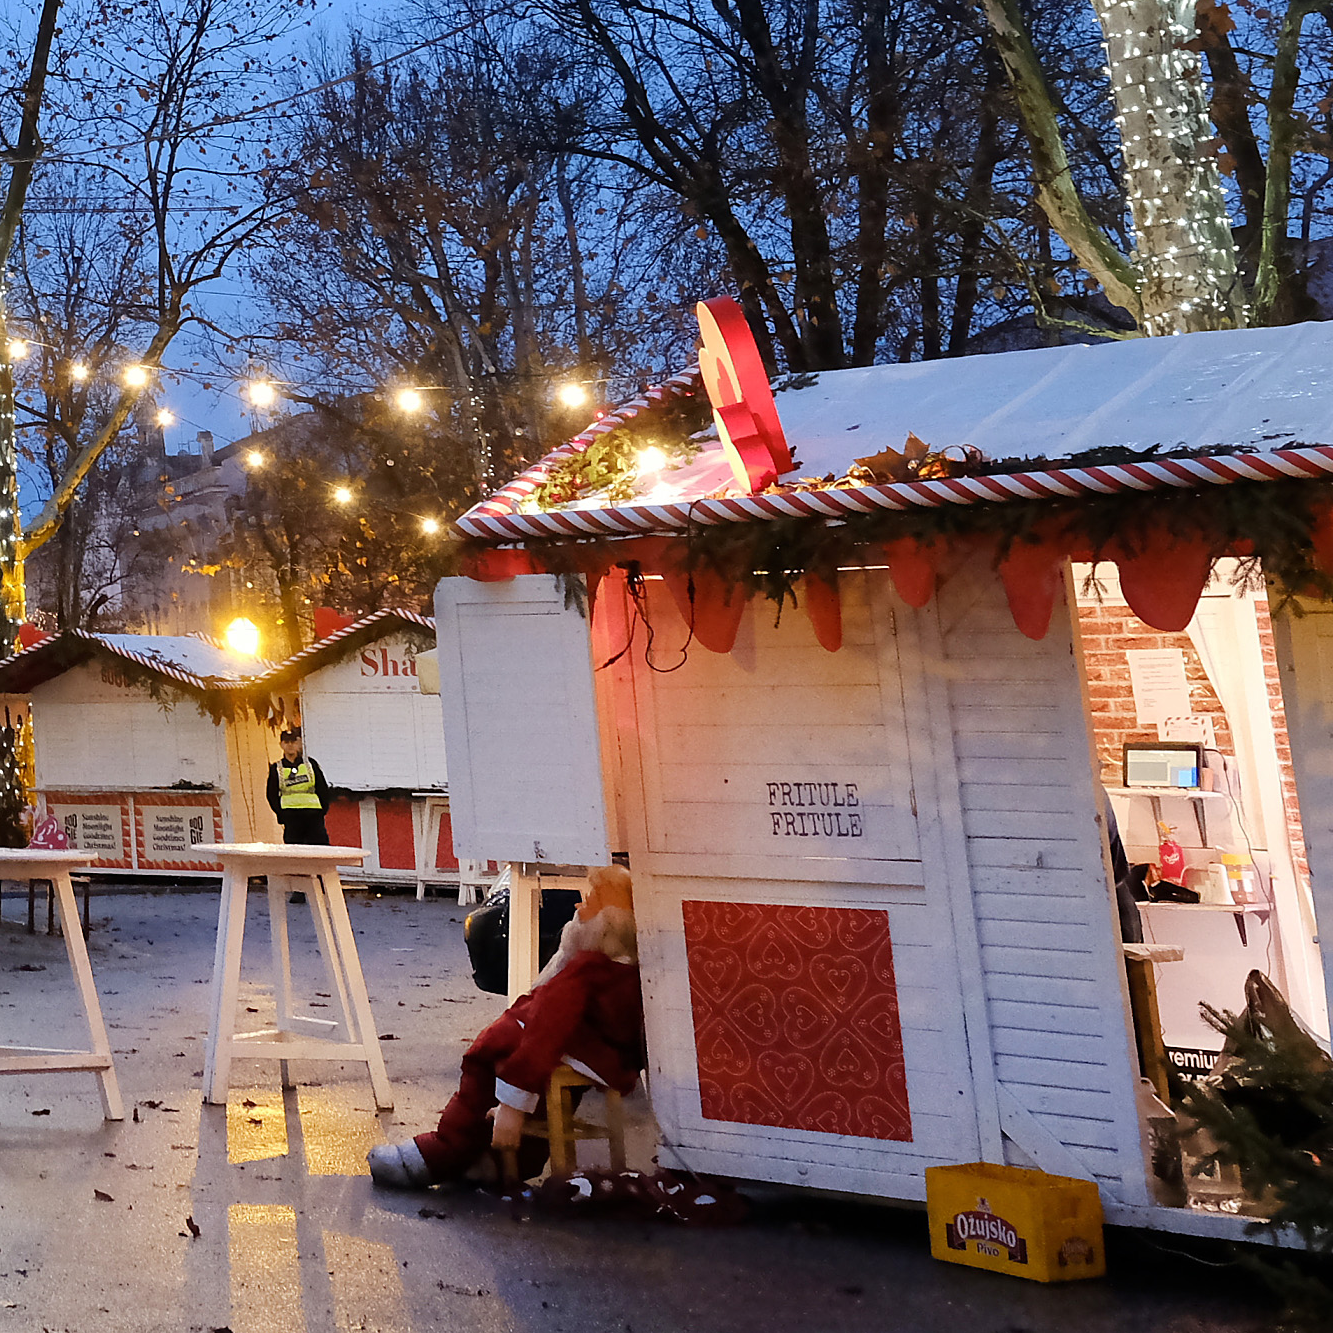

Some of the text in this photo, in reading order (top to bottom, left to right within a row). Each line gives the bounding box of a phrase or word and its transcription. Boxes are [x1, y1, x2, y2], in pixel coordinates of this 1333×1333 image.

[361, 648, 419, 677] Sha
[766, 782, 859, 807] FRITULE
[769, 812, 863, 838] FRITULE
[1168, 1050, 1219, 1070] remiu
[956, 1214, 1017, 1248] Ožujsko
[976, 1242, 1000, 1257] Pivo
